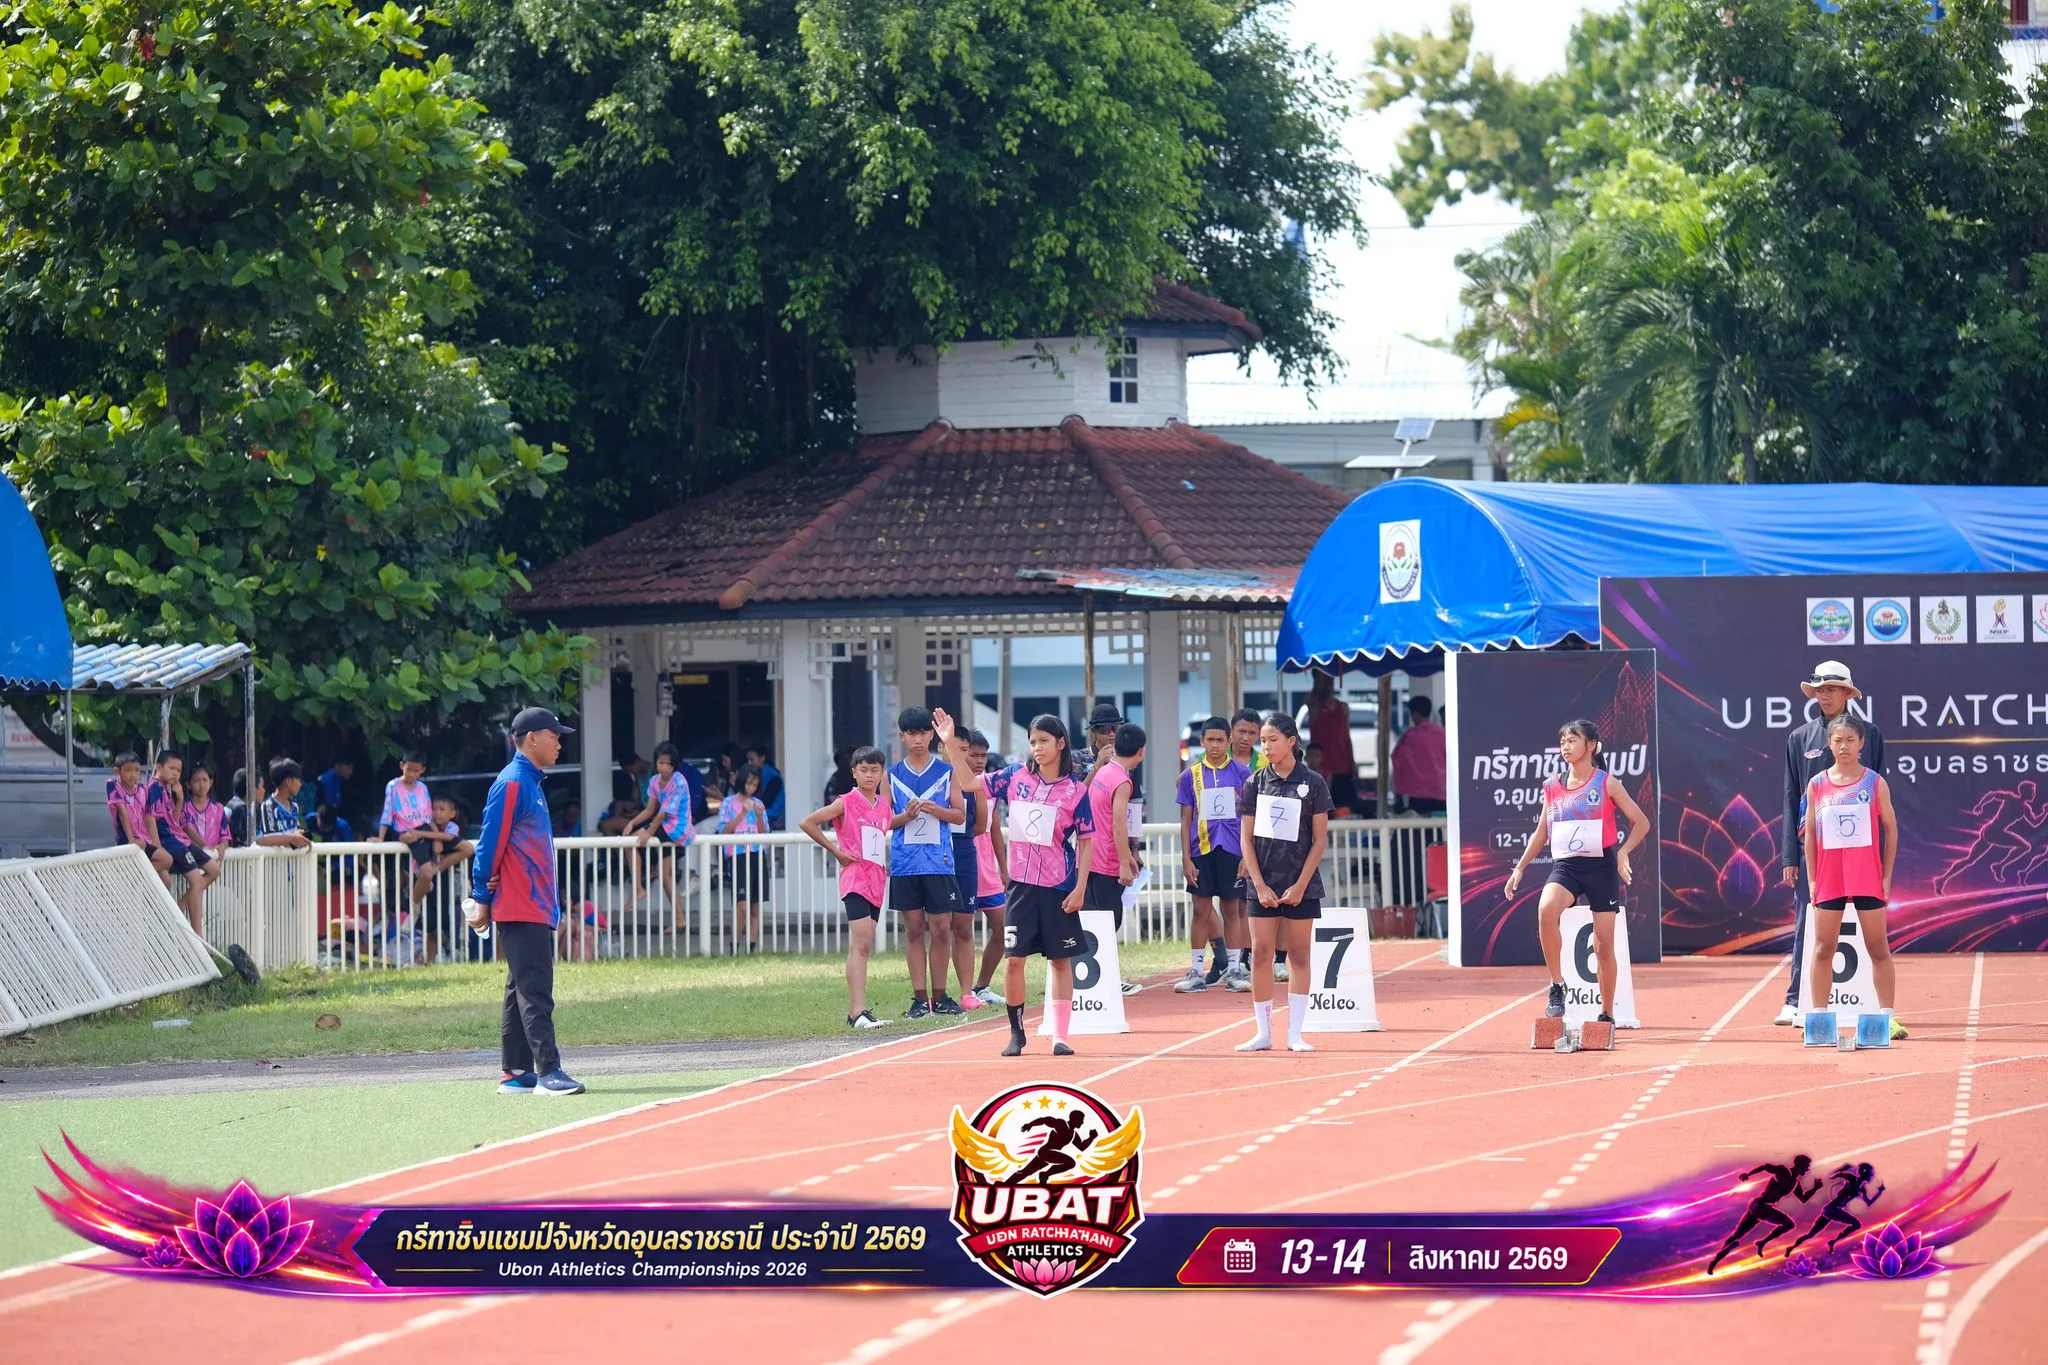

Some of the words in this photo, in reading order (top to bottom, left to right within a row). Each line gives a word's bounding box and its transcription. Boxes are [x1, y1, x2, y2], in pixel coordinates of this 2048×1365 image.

[1901, 693, 2048, 727] RATCH
[1213, 794, 1225, 814] 6
[914, 817, 927, 837] 2
[1025, 809, 1043, 838] 8
[1270, 805, 1288, 828] 7
[1839, 815, 1856, 837] 5
[871, 833, 880, 856] 1
[1568, 825, 1584, 851] 6
[1004, 925, 1018, 949] 5
[1315, 928, 1355, 989] 7
[1071, 996, 1103, 1011] elco
[1310, 993, 1356, 1010] Nelco
[1568, 987, 1602, 1005] Nelc
[1828, 988, 1860, 1006] elco
